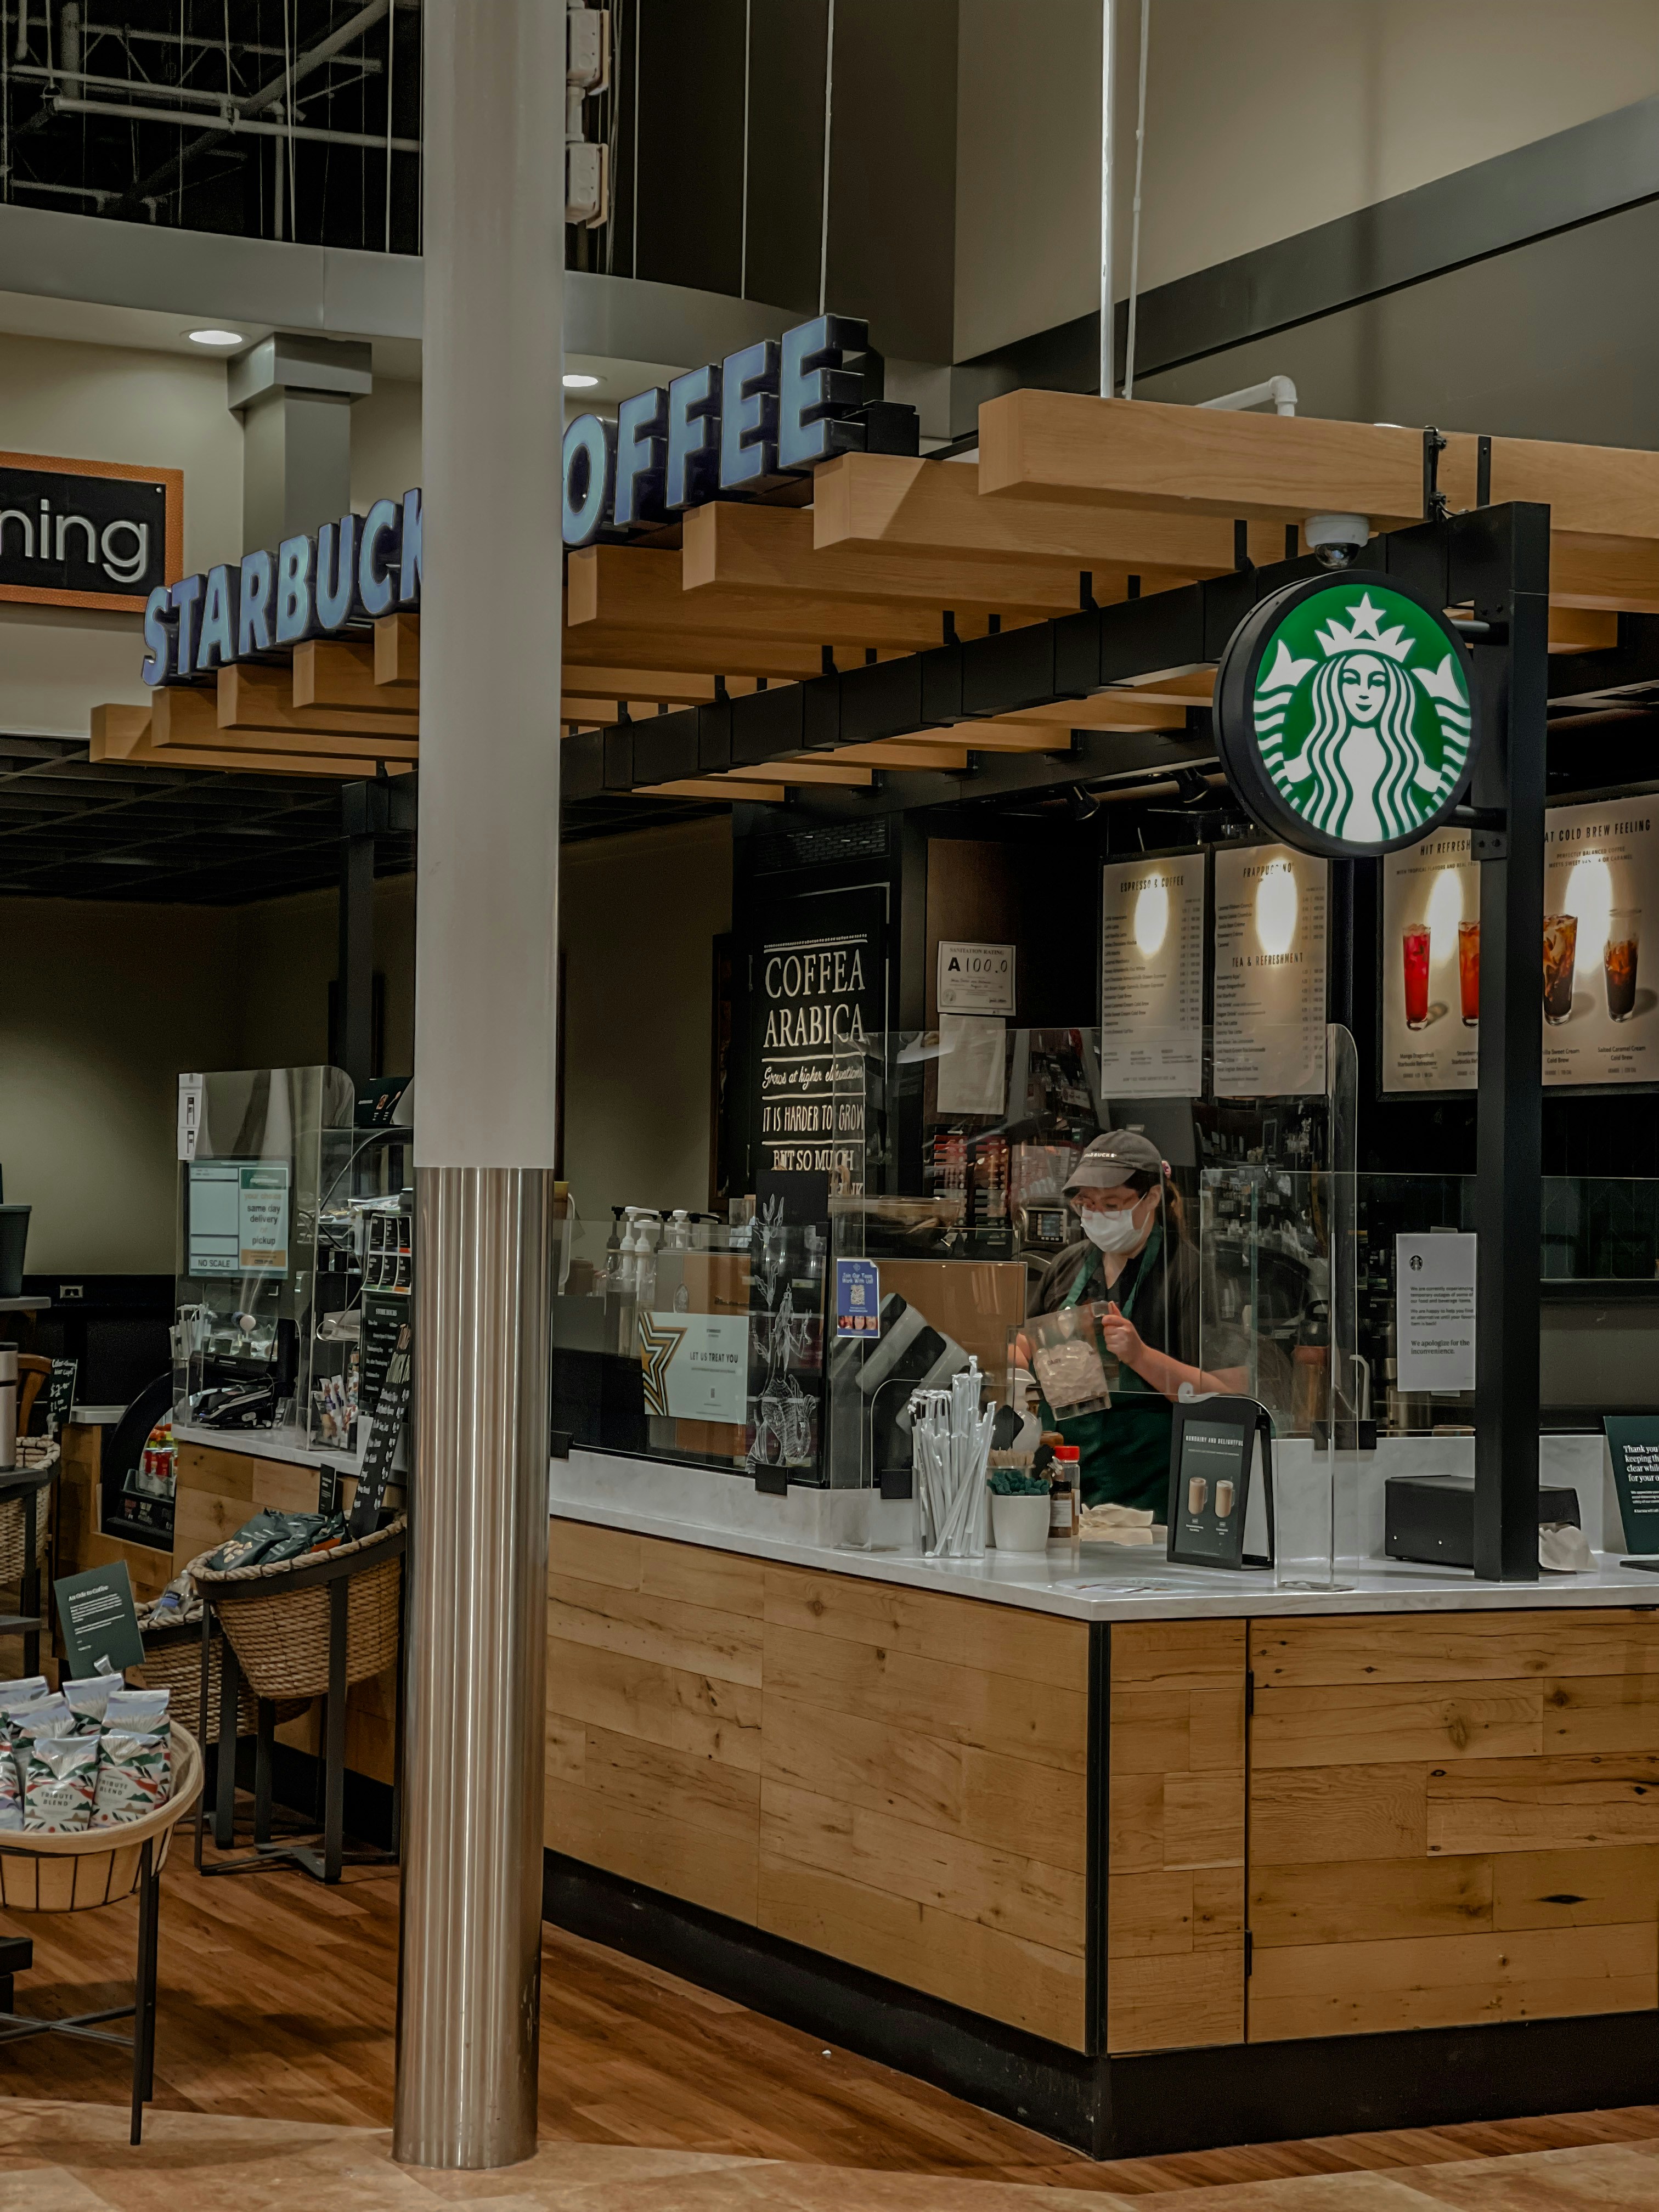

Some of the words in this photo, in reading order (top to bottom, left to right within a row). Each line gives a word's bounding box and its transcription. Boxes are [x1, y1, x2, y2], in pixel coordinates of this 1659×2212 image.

[141, 488, 422, 686] STARBUCK
[562, 314, 827, 545] OFFEE
[1545, 832, 1554, 843] AT
[1559, 828, 1581, 841] COLD
[1586, 825, 1610, 838] BREW
[1615, 820, 1650, 834] FEELING
[1420, 844, 1432, 855] HIT
[1437, 839, 1471, 854] REFRESH
[1121, 879, 1150, 892] ESPRESSO
[1161, 876, 1183, 887] COFFEE
[948, 957, 960, 972] A
[967, 957, 1007, 973] 100.0
[1233, 957, 1243, 967] TEA
[1247, 957, 1251, 966] &
[1256, 952, 1303, 966] REFRESHMENT
[765, 949, 865, 998] COFFEA
[763, 1003, 865, 1048] ARABICA
[762, 1066, 786, 1089] Grows
[788, 1070, 798, 1083] at
[798, 1066, 822, 1090] higher
[763, 1107, 771, 1132] IT
[774, 1107, 781, 1131] IS
[785, 1105, 819, 1131] HARDER
[822, 1105, 832, 1131] TO
[838, 1104, 864, 1131] GROW
[796, 1150, 812, 1171] SO
[268, 1204, 280, 1215] day
[250, 1215, 278, 1225] delivery
[252, 1236, 275, 1246] pickup
[1421, 1340, 1449, 1348] apologize
[690, 1352, 698, 1360] LET
[701, 1352, 707, 1361] US
[709, 1353, 724, 1363] TREAT
[726, 1354, 738, 1363] YOU
[1623, 1444, 1645, 1453] Thank
[1625, 1454, 1652, 1464] keeping
[1627, 1464, 1643, 1472] clear
[1628, 1474, 1638, 1482] for
[41, 1792, 73, 1800] TRIBUTE
[99, 1786, 122, 1796] BLEND
